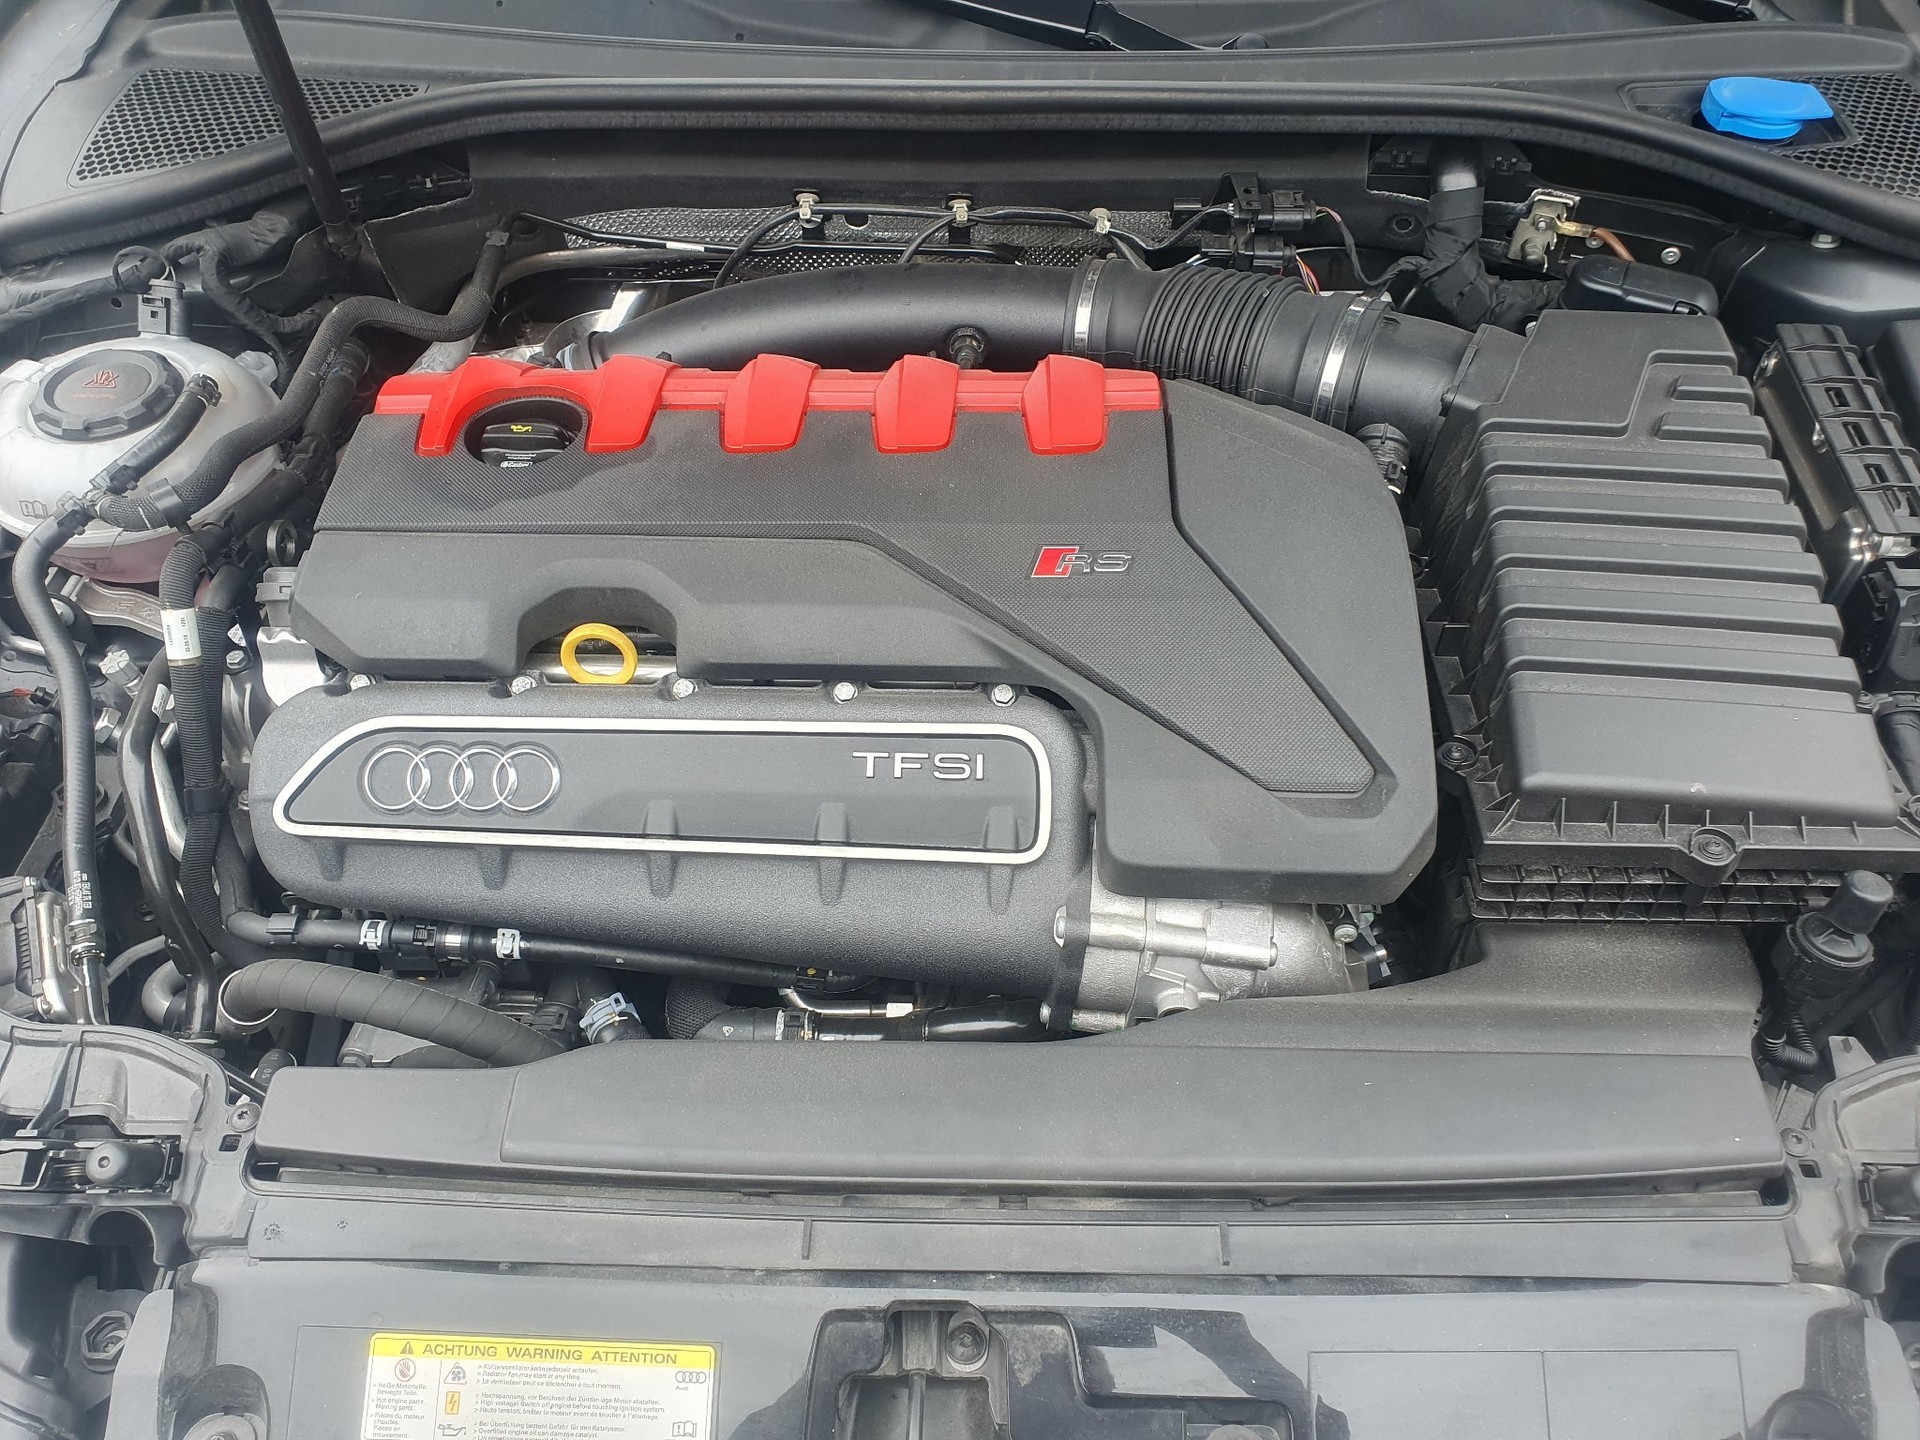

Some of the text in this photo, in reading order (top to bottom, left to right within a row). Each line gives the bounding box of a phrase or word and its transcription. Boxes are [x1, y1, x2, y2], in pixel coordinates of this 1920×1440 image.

[1048, 549, 1133, 575] RS
[852, 752, 984, 780] TFSI
[422, 1343, 678, 1365] ACHTUNG WARNING ATTENTION
